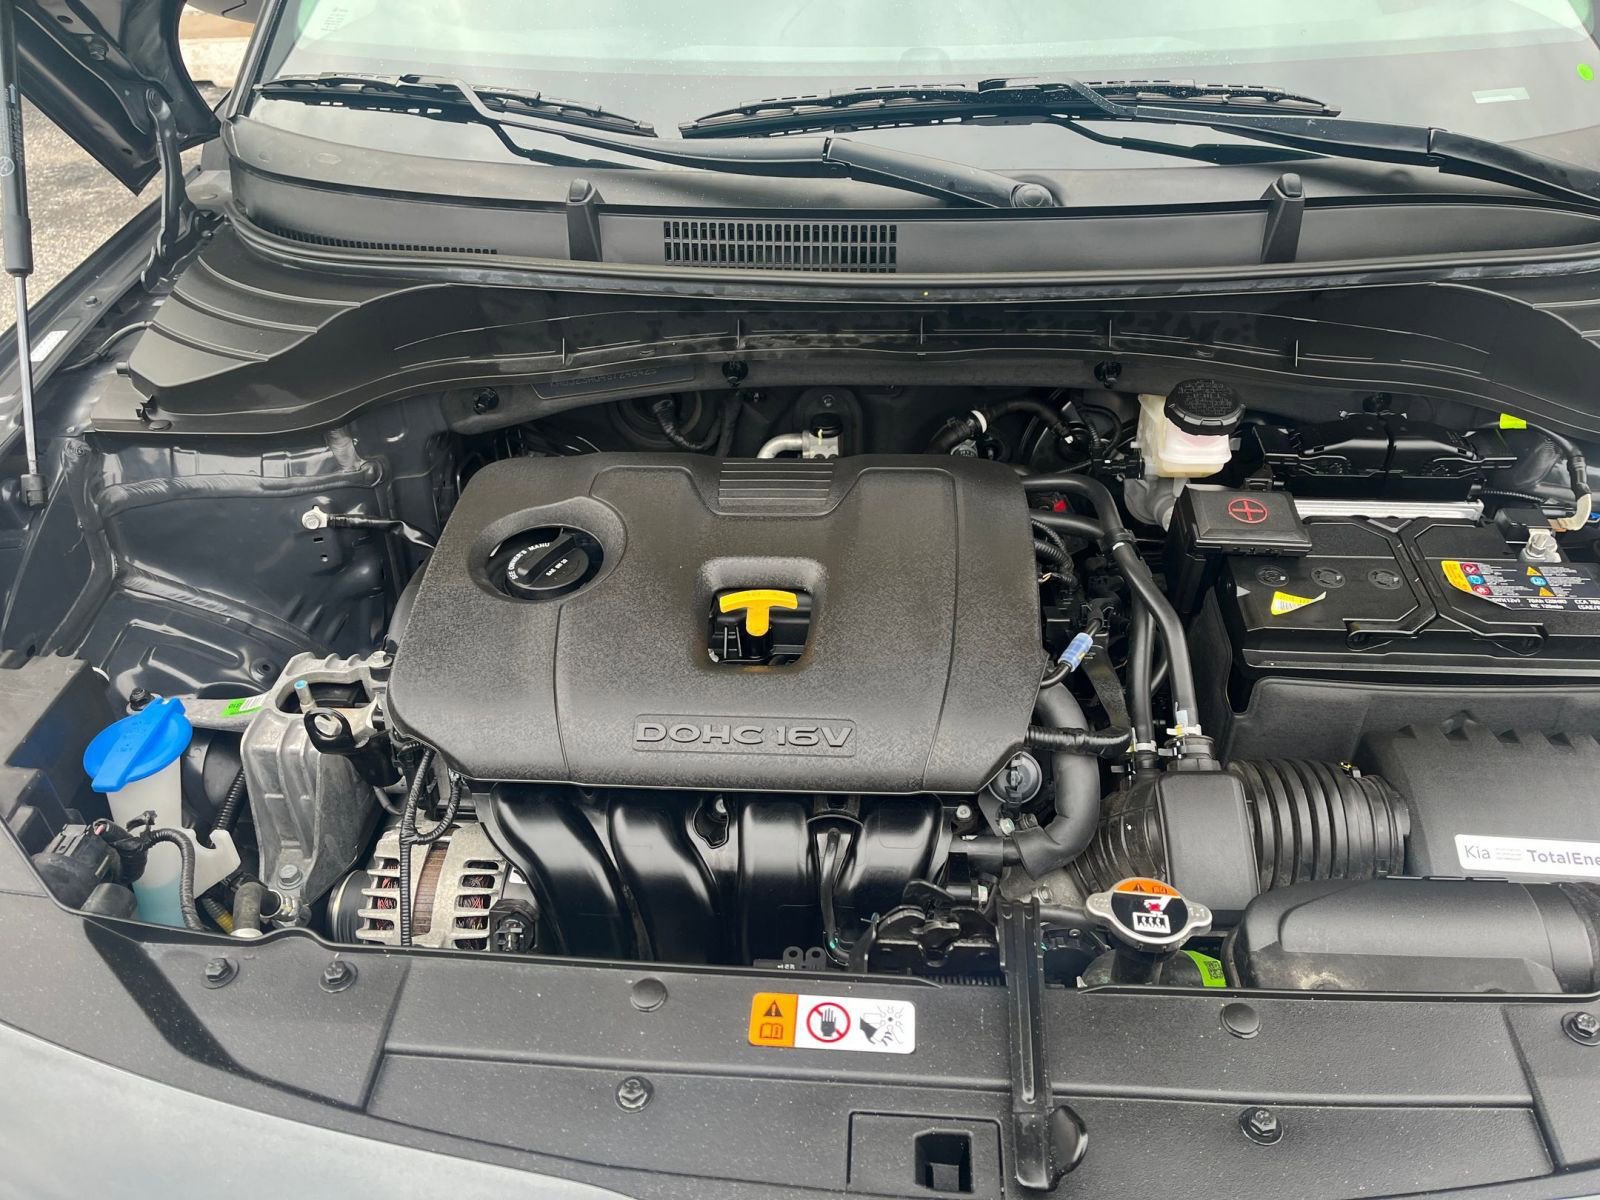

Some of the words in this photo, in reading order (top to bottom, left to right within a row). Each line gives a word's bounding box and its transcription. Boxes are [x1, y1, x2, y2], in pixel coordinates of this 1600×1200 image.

[636, 722, 765, 745] DOHC
[776, 725, 853, 748] 16V
[1464, 844, 1491, 860] Kia
